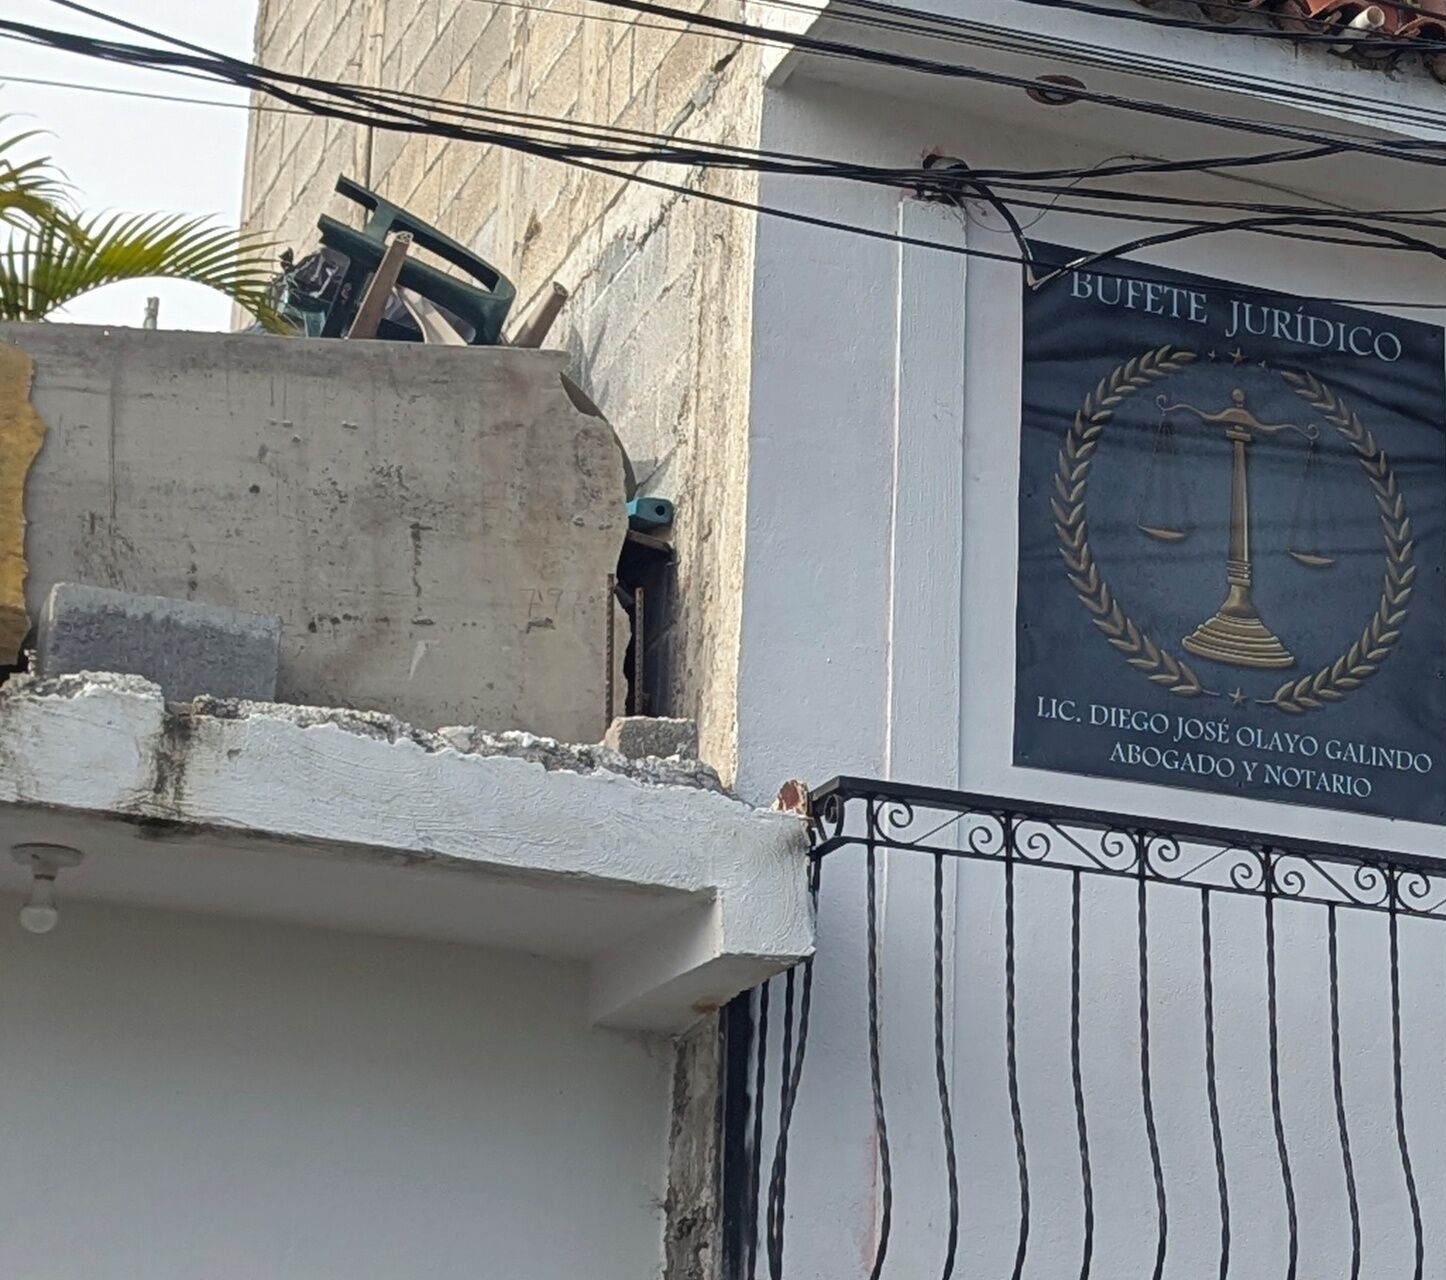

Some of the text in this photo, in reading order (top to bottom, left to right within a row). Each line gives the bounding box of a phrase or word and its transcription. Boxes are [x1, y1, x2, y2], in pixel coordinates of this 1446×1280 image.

[1070, 270, 1402, 363] BUFETE JURÍDICO
[1036, 696, 1433, 774] LIC. DIEGO JOSÉ OLAYO GALINDO
[1109, 742, 1373, 798] ABOGADO Y NOTARIO
